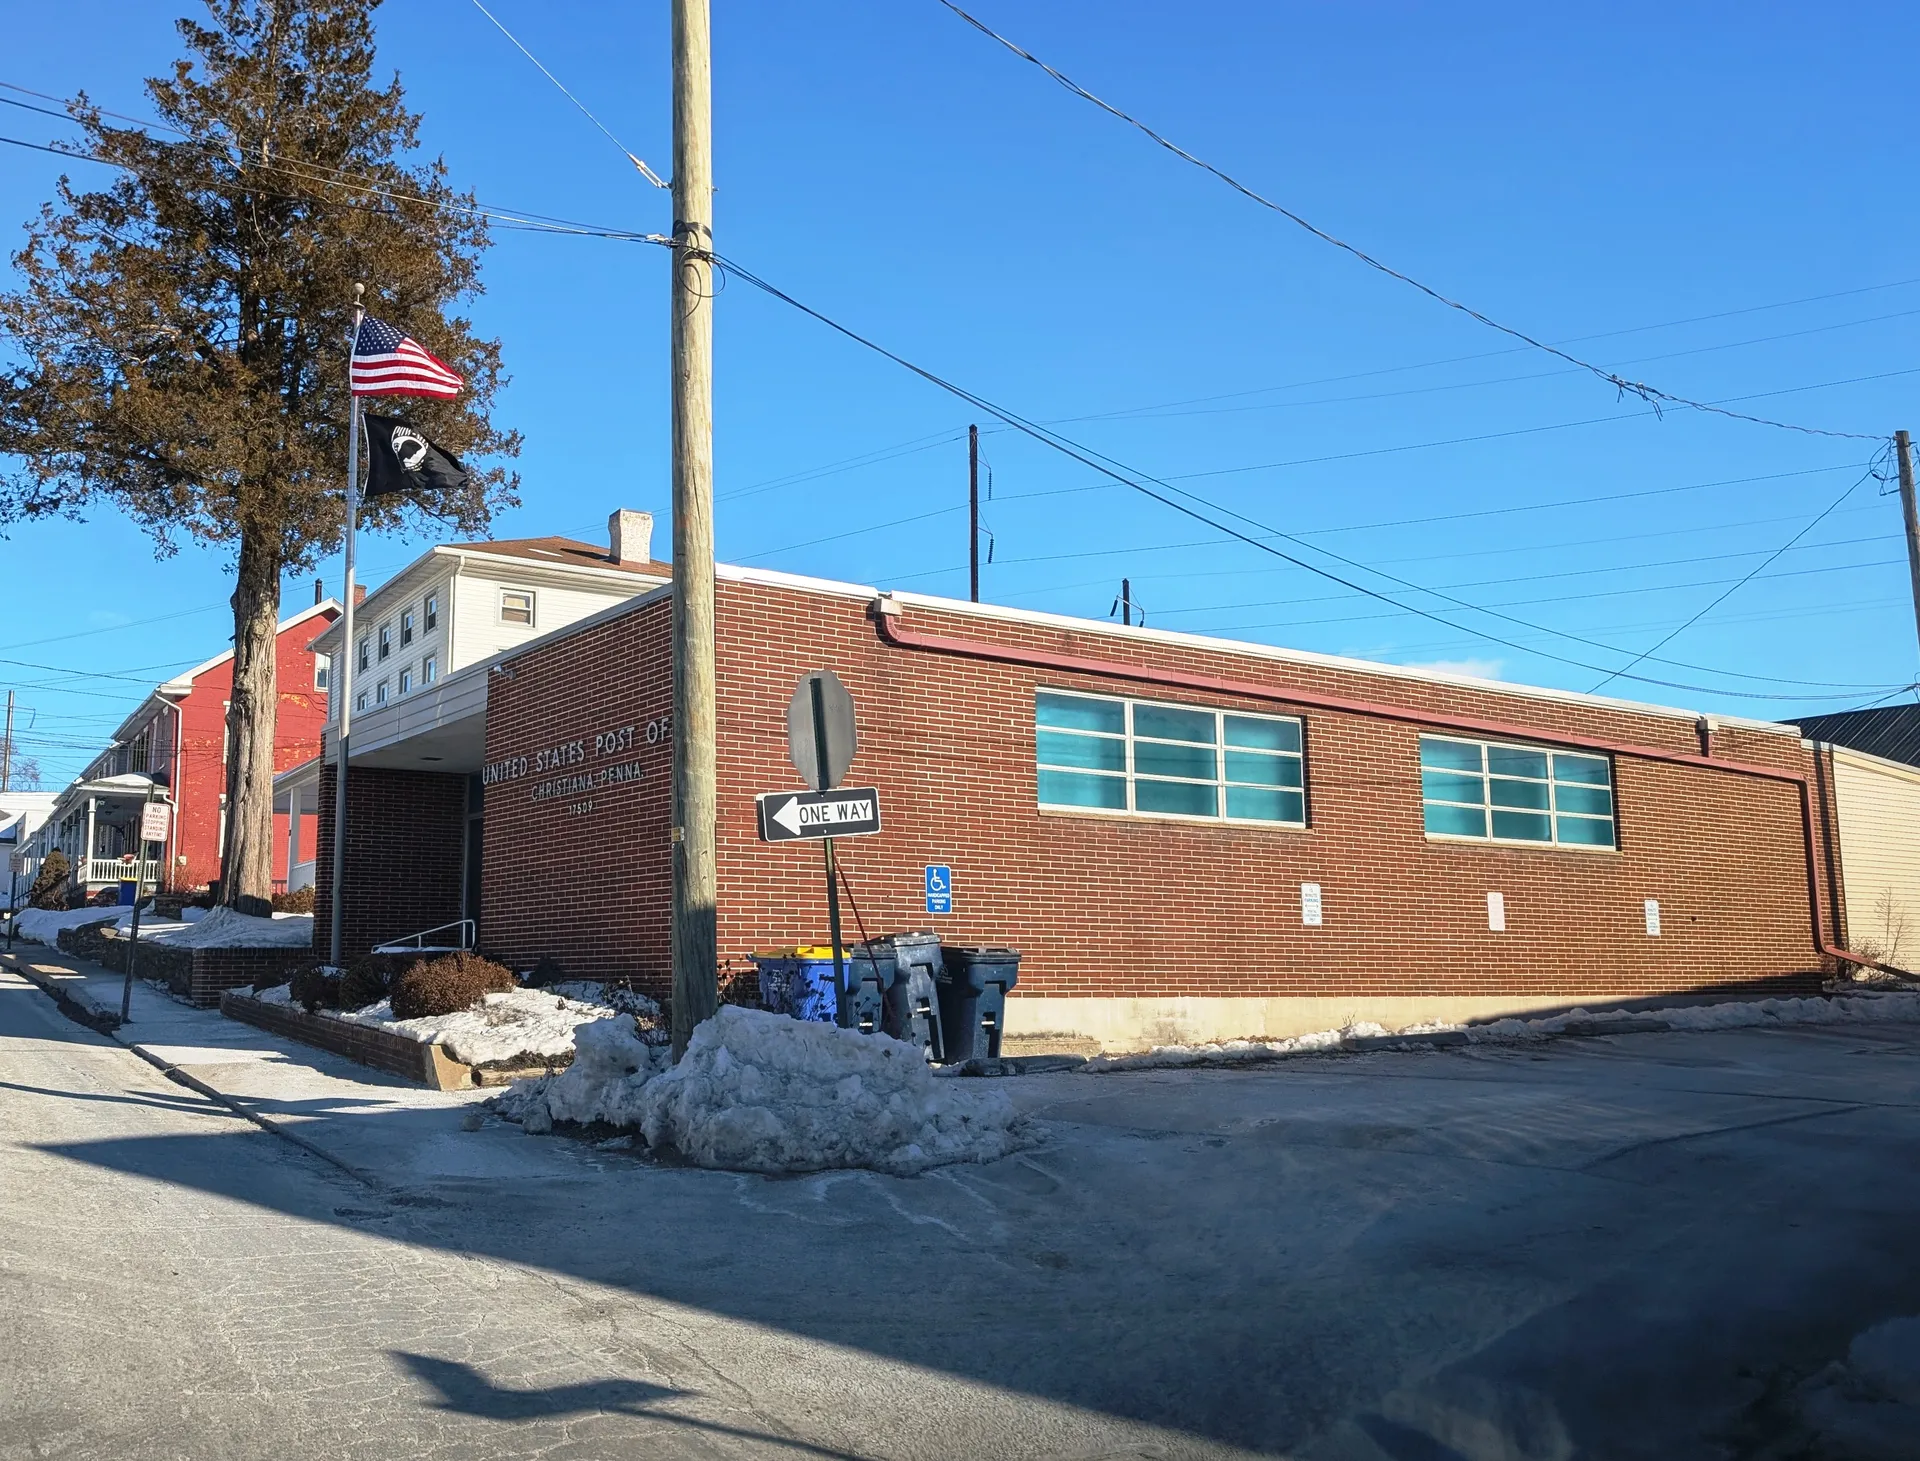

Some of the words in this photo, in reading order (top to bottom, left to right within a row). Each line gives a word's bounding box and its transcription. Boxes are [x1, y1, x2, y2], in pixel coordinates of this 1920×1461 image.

[482, 757, 528, 785] UNITED
[536, 740, 585, 772] STATES
[595, 726, 635, 757] POST
[601, 761, 644, 785] PENNA.
[569, 800, 593, 816] 17509
[799, 805, 831, 824] ONE
[836, 802, 869, 821] WAY
